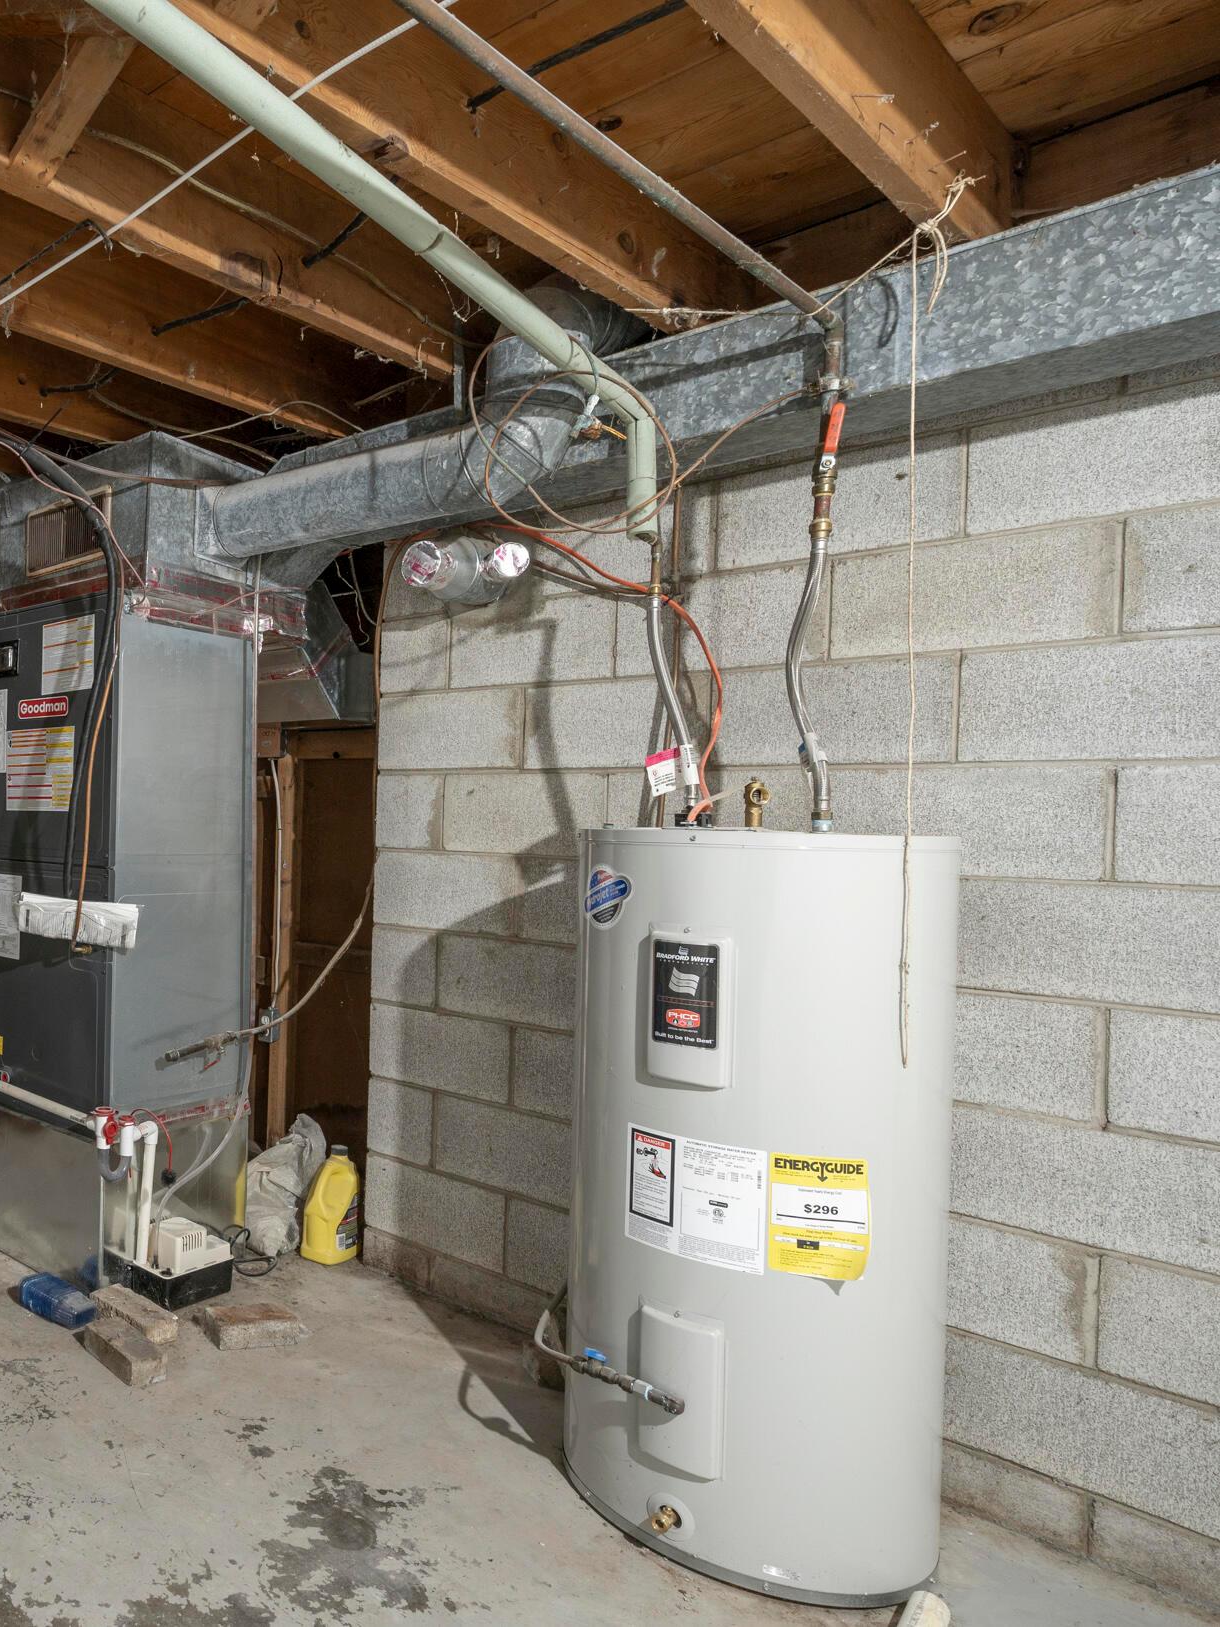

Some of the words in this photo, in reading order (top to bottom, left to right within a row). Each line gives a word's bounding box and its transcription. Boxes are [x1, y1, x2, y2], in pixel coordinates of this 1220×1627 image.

[21, 702, 66, 714] Goodman
[656, 952, 689, 961] BRADFORD
[691, 956, 716, 964] WHITE
[668, 1011, 699, 1020] PHCC
[697, 1037, 712, 1045] Best
[643, 1137, 666, 1146] DANGER
[774, 1157, 864, 1175] ENERGYGUIDE
[804, 1203, 839, 1216] $296
